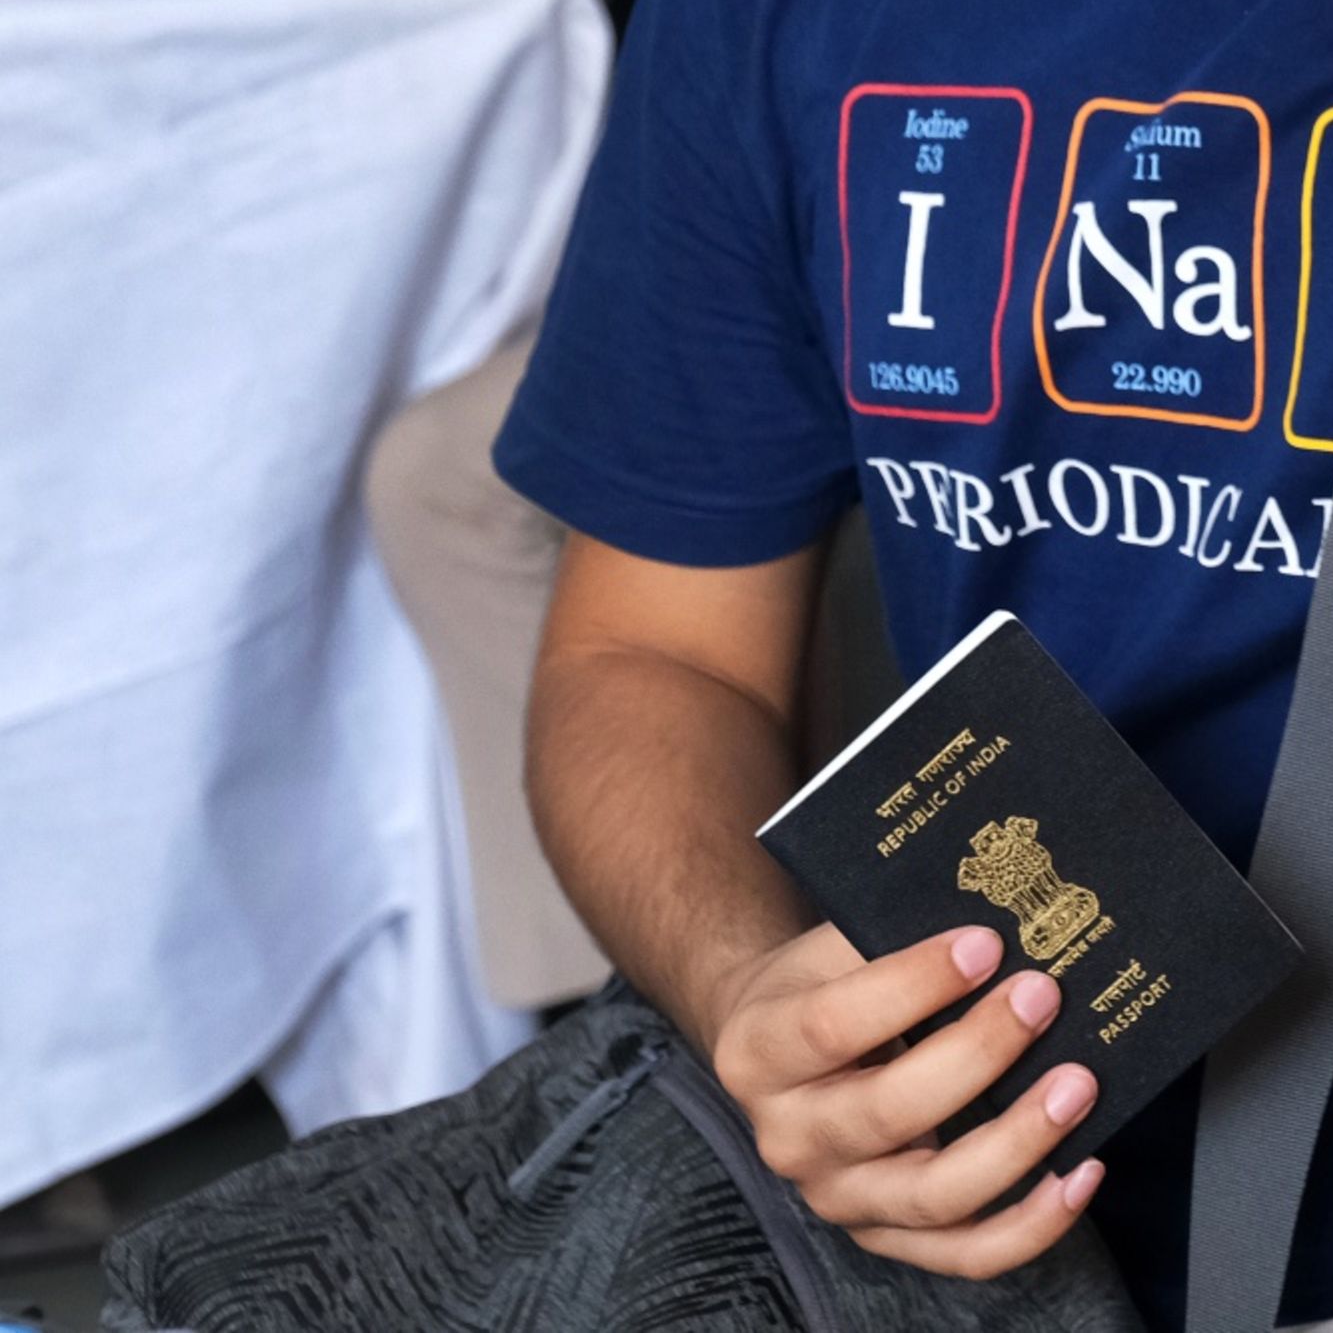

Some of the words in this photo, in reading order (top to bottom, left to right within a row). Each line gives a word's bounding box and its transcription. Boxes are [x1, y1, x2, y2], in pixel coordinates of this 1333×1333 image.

[903, 109, 969, 140] Iodine
[915, 144, 944, 174] 53
[1132, 152, 1162, 181] 11
[887, 191, 945, 331] I
[1054, 199, 1252, 342] Na
[867, 361, 960, 396] 126.9045
[1112, 361, 1202, 397] 22.990
[875, 781, 918, 818] भारत
[876, 790, 949, 858] REPUBLIC
[944, 770, 967, 795] OF
[965, 735, 1012, 776] INDIA
[1089, 957, 1148, 1012] पासपोर्ट
[1098, 973, 1172, 1045] PASSPORT
